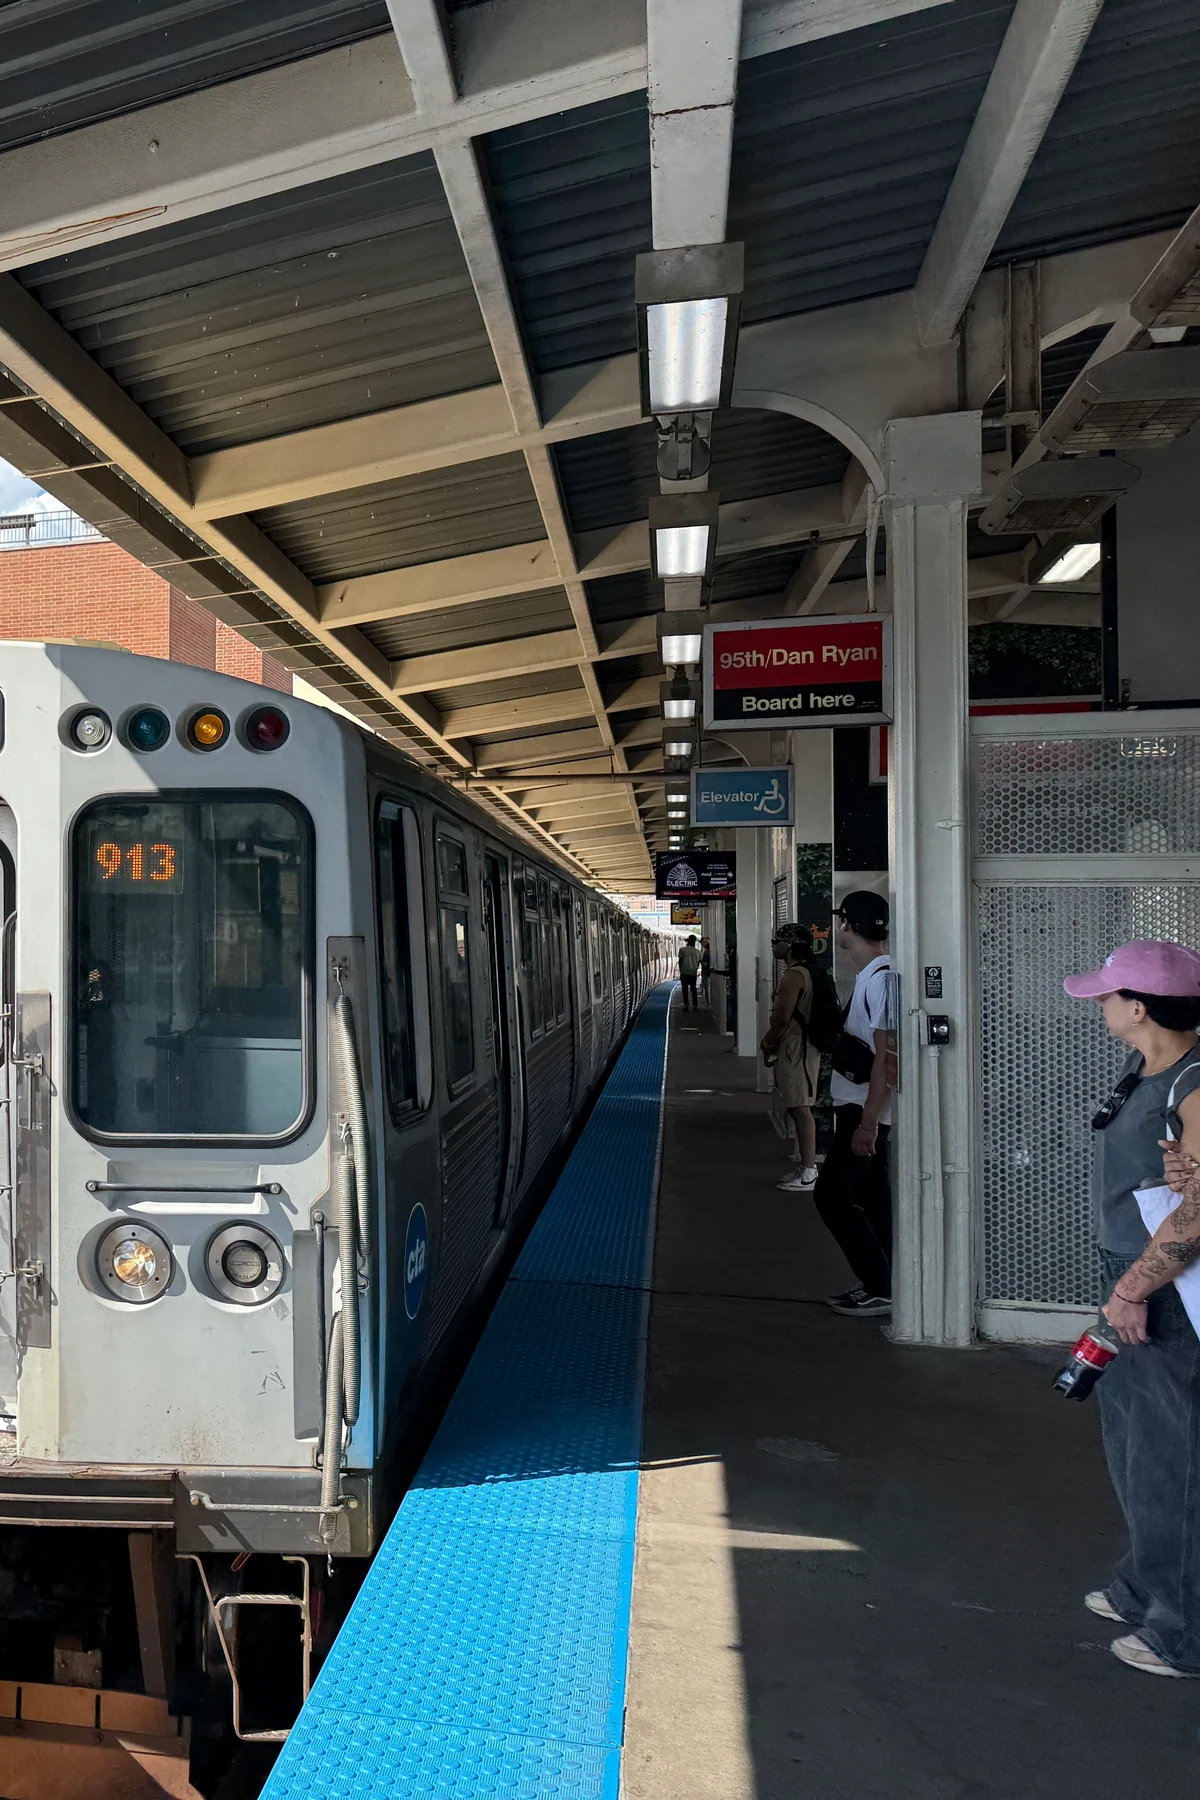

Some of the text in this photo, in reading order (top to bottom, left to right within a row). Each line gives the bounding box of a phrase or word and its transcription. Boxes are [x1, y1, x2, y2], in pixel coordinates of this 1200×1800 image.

[719, 645, 878, 669] 95th/Dan Ryan
[742, 693, 802, 712] Board
[809, 692, 855, 709] here
[700, 791, 759, 803] Elevator
[96, 843, 175, 880] 913
[406, 1238, 426, 1284] cta
